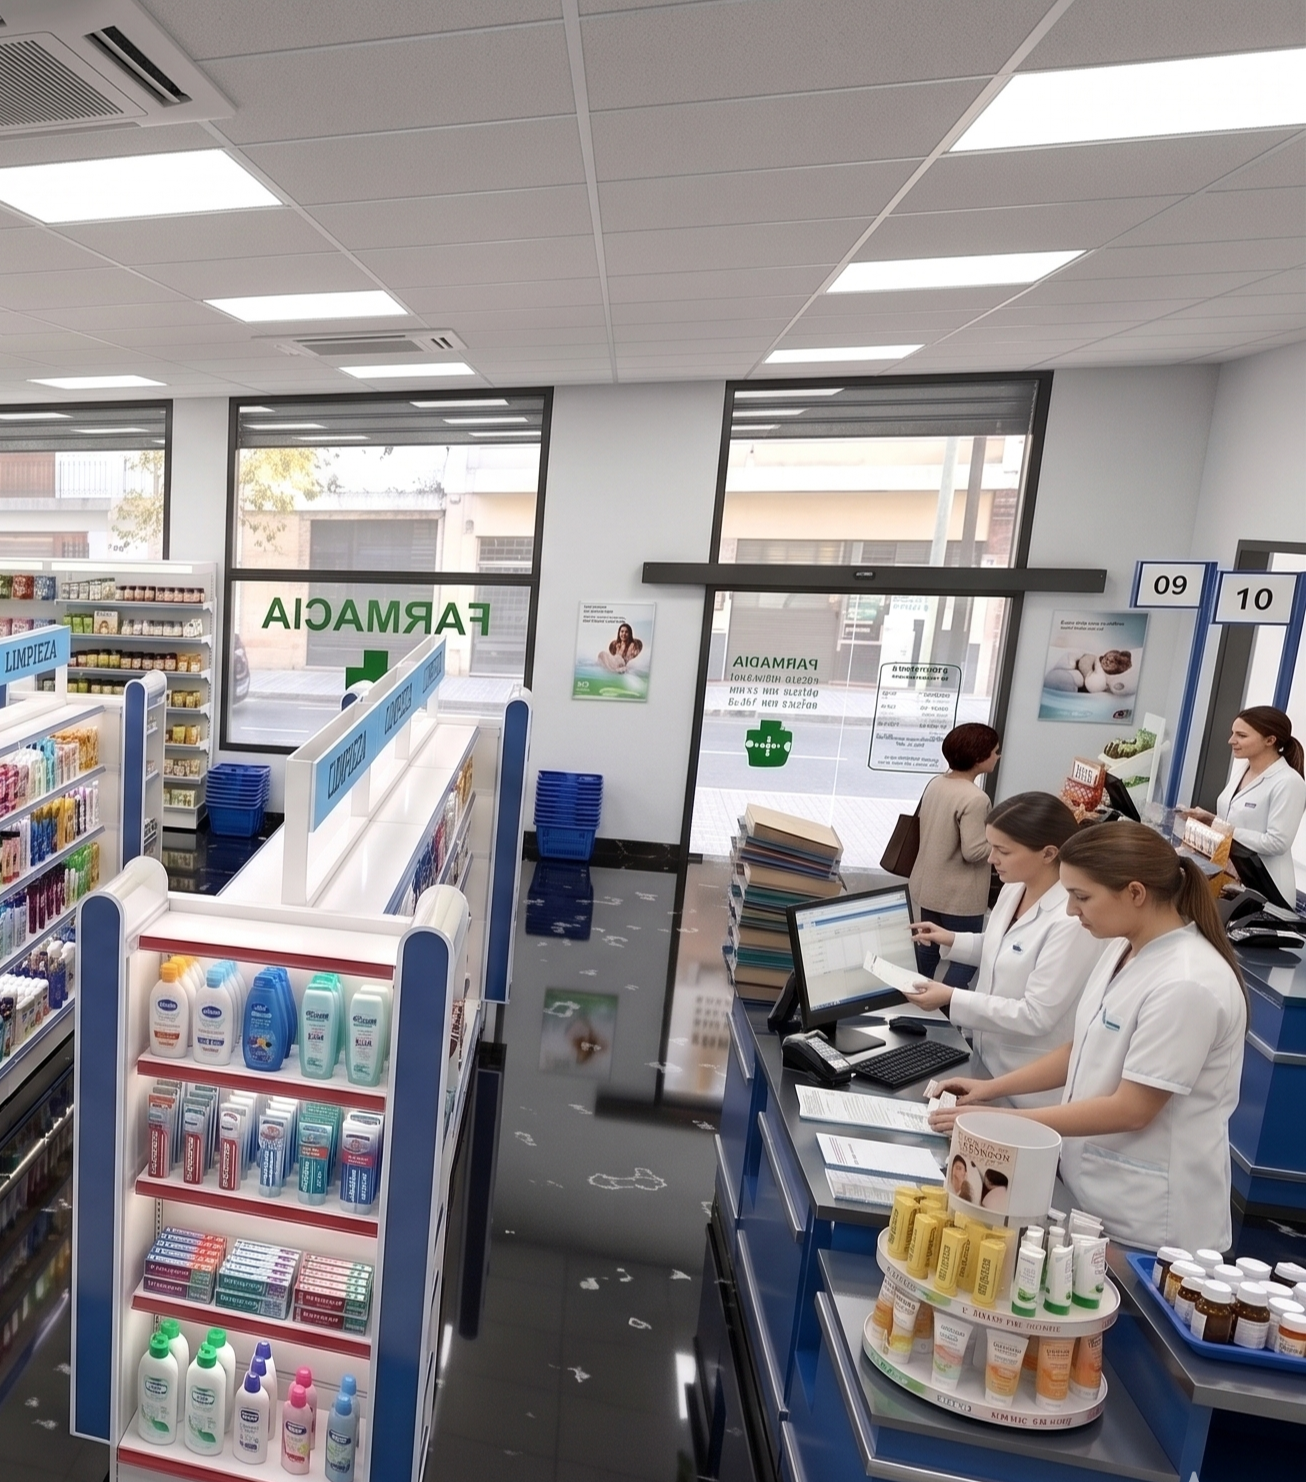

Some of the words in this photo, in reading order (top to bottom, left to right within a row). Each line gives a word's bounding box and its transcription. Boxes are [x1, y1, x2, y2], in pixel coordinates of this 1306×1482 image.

[1154, 575, 1188, 595] 09
[1237, 588, 1273, 610] 10
[4, 640, 57, 673] LIMPIEZA
